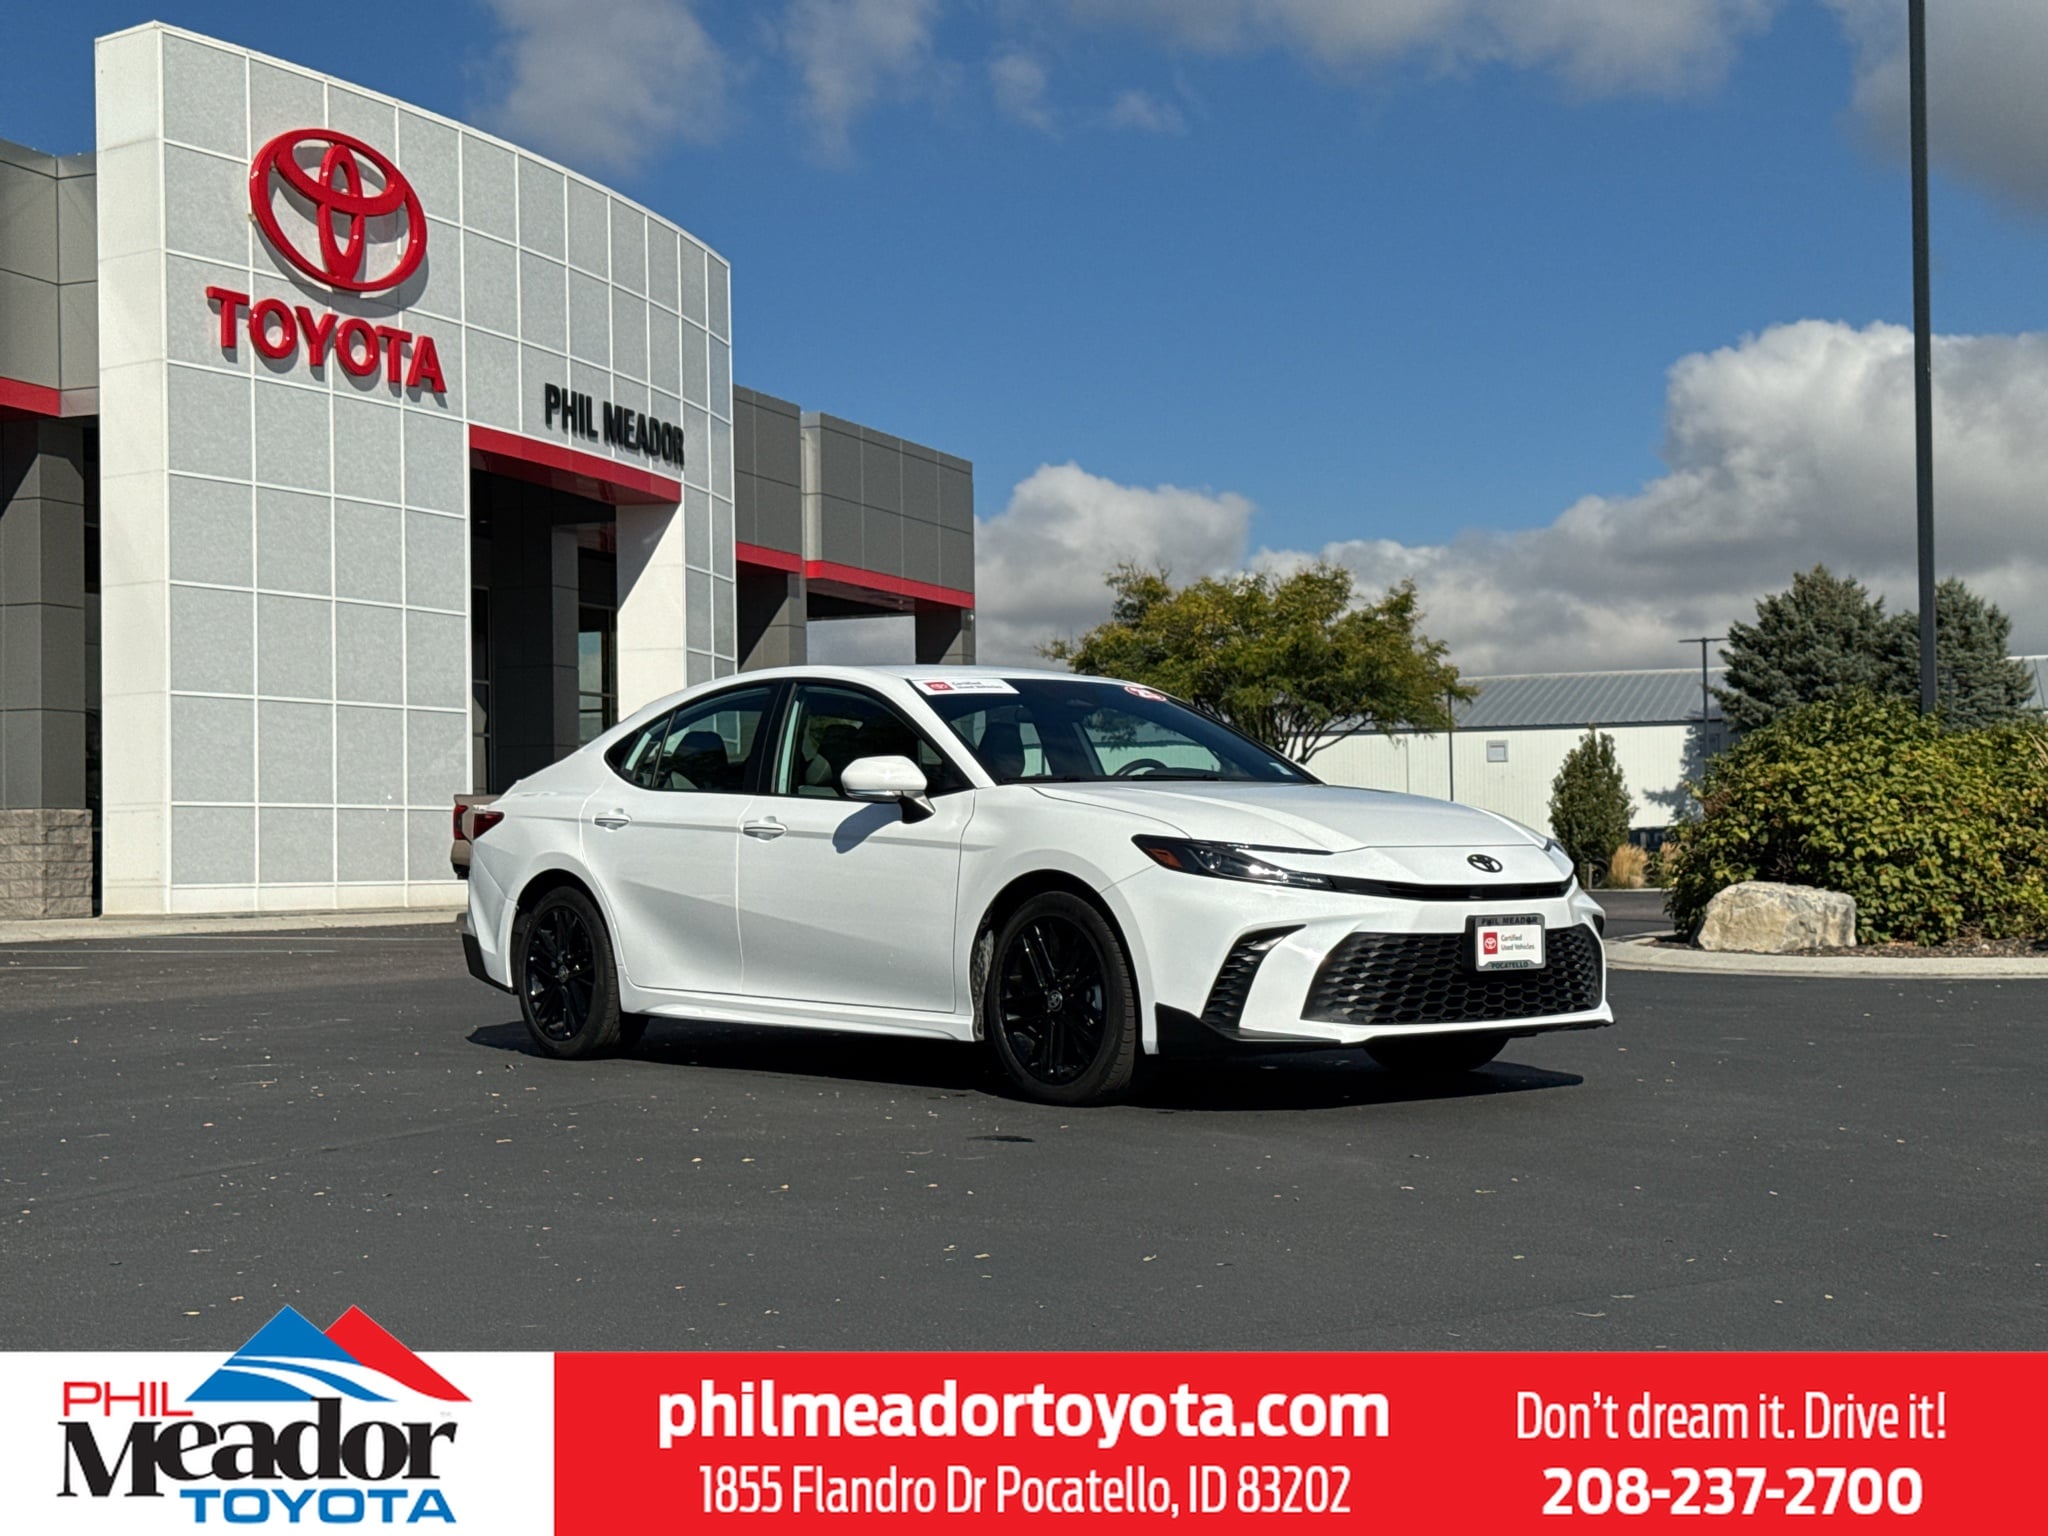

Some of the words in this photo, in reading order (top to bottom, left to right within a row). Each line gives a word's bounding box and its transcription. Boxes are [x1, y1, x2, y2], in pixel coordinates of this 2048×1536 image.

[206, 286, 447, 393] TOYOTA
[545, 383, 598, 439] PHIL
[603, 400, 685, 467] MEADOR
[1502, 916, 1538, 924] MEADOR
[1490, 961, 1529, 969] POCATELLO
